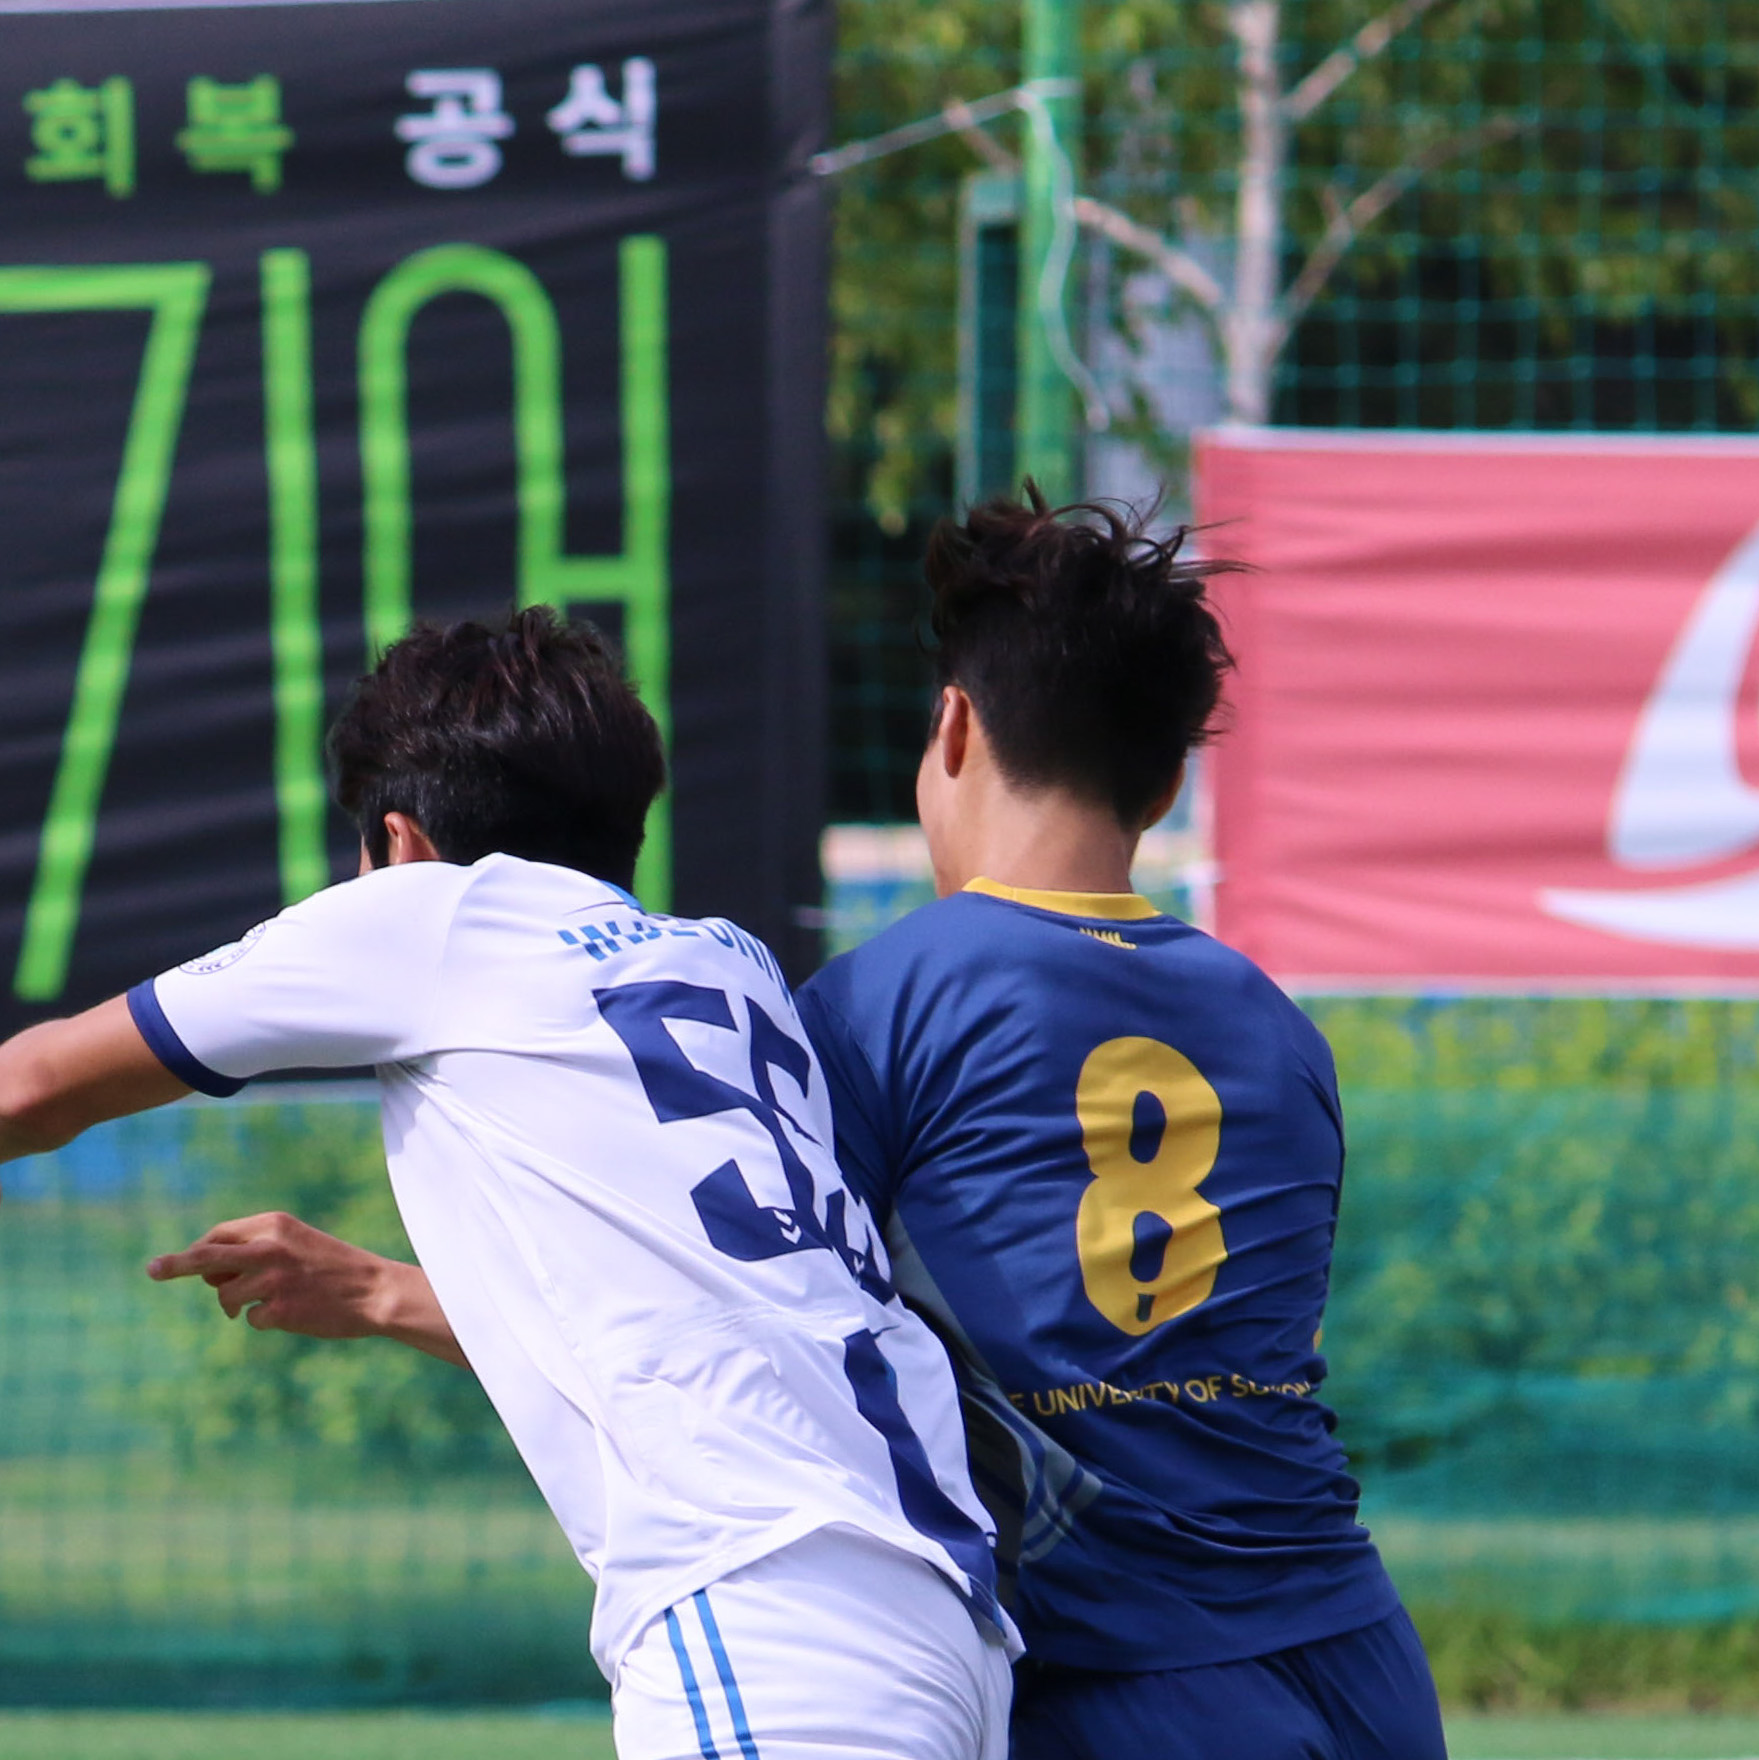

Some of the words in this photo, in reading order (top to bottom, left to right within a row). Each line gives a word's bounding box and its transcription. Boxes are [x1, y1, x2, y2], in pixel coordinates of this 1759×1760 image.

[23, 76, 293, 195] 회복
[396, 59, 656, 186] 공식
[1076, 1036, 1227, 1335] 8
[1184, 1376, 1222, 1402] OF
